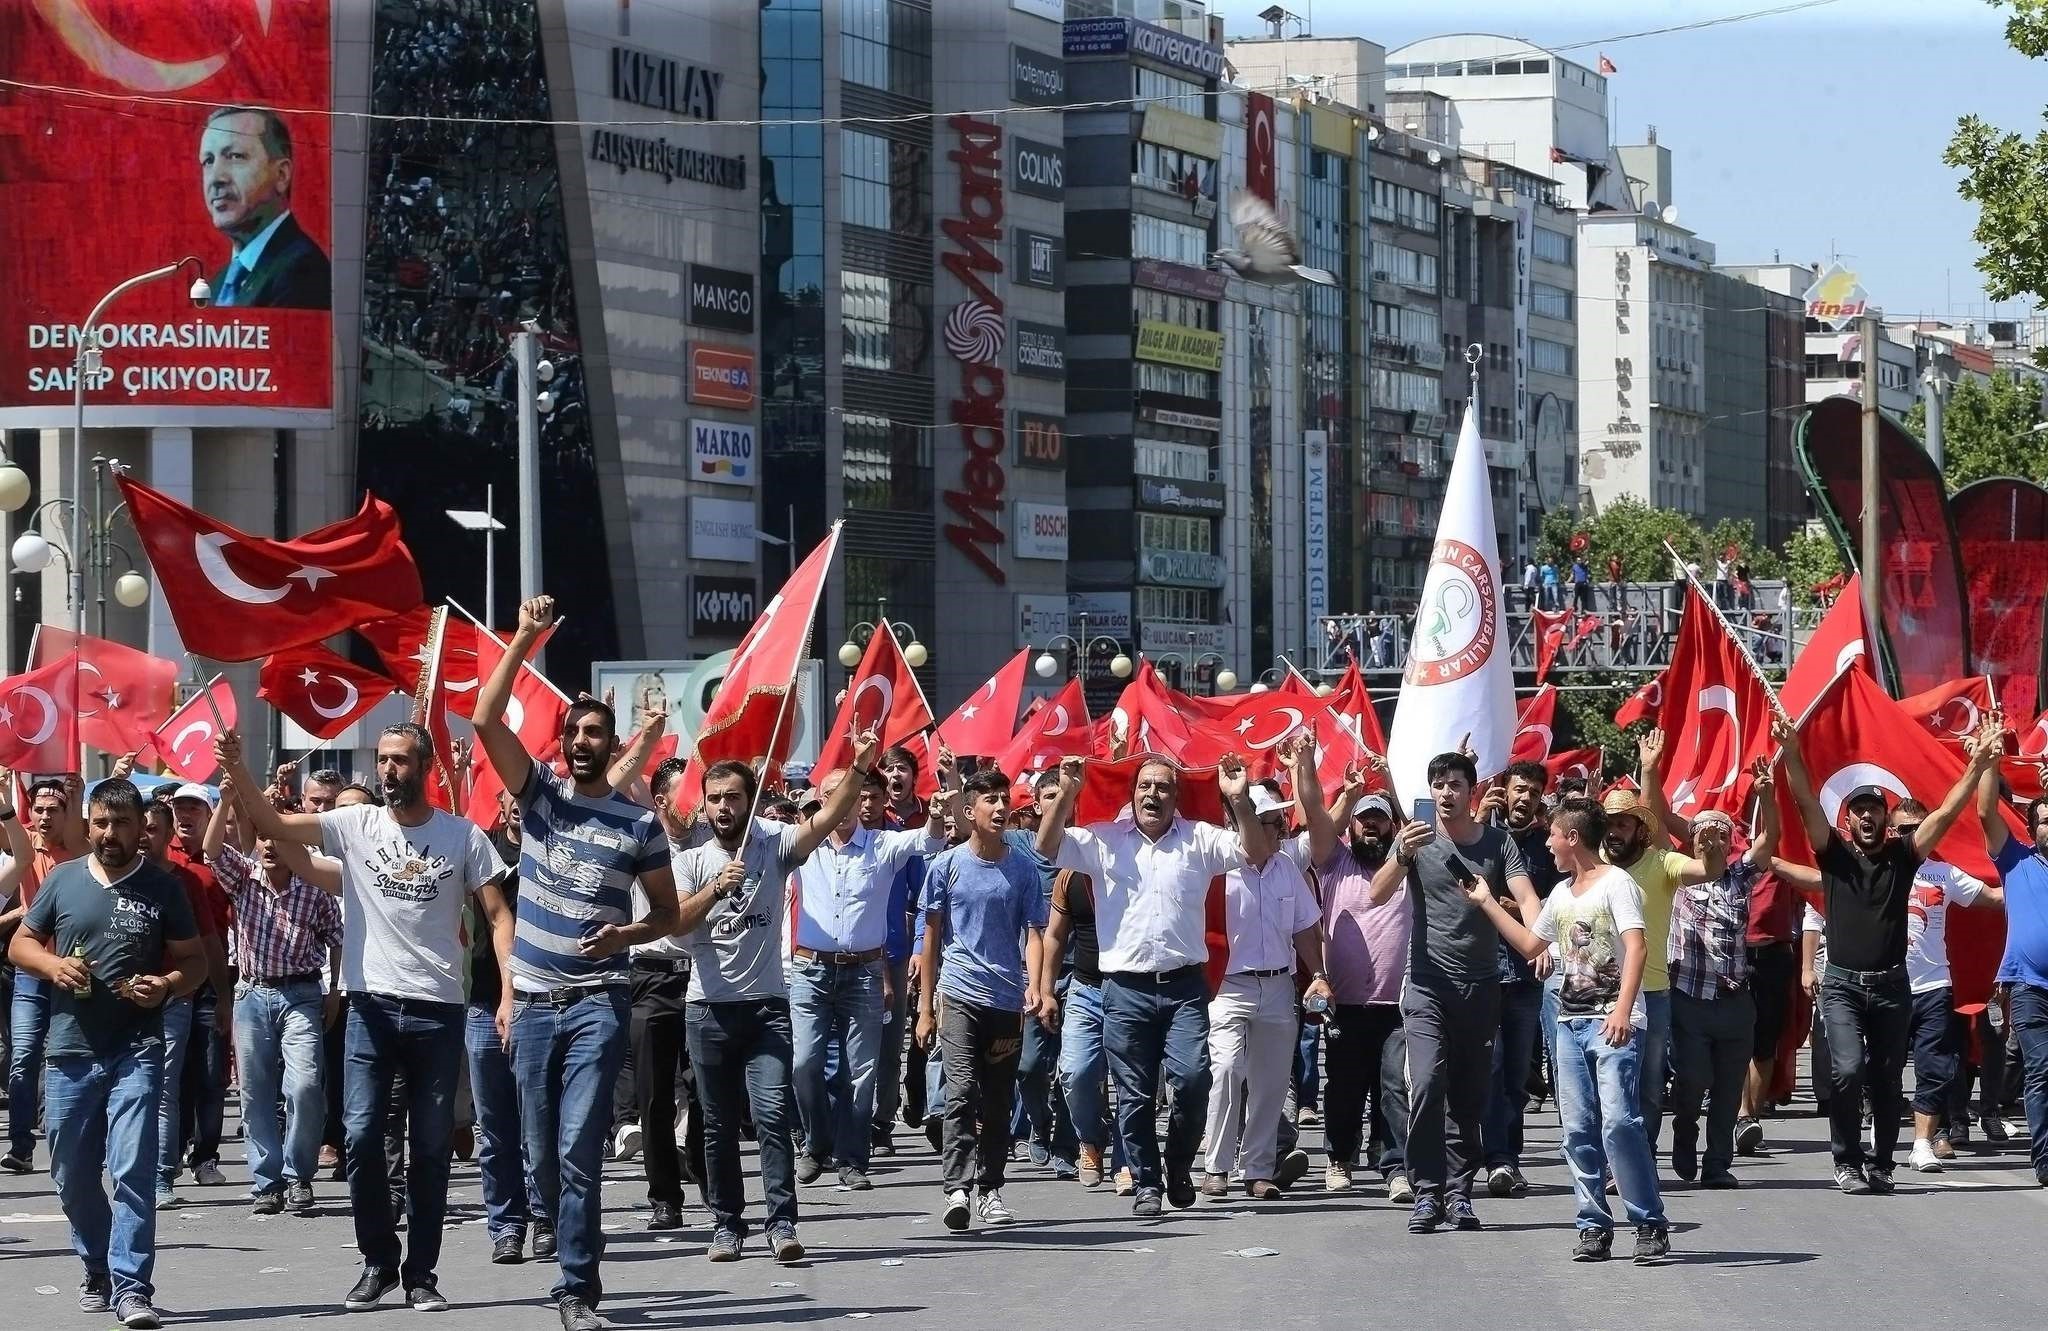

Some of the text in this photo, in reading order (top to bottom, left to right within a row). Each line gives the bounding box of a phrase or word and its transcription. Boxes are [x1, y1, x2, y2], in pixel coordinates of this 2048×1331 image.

[611, 47, 725, 121] KIZILAY
[1016, 58, 1064, 94] hatemoğlu
[590, 130, 677, 184] ALIŞVERİŞ
[1018, 150, 1063, 188] COLIN'S
[1031, 240, 1052, 273] LOFT
[693, 282, 751, 315] MANGO
[1809, 300, 1866, 316] final
[940, 110, 1005, 586] Media Markt
[1019, 346, 1063, 369] COSMETICS
[122, 366, 278, 397] ÇIKIYORUZ.
[696, 427, 751, 458] MAKRO
[1024, 420, 1061, 460] FLO
[695, 520, 729, 537] ENGLISH
[1035, 513, 1067, 538] BOSCH
[1308, 465, 1324, 560] SİSTEM
[1431, 544, 1460, 563] UN
[365, 840, 453, 881] CHICAGO
[373, 873, 440, 898] Strength
